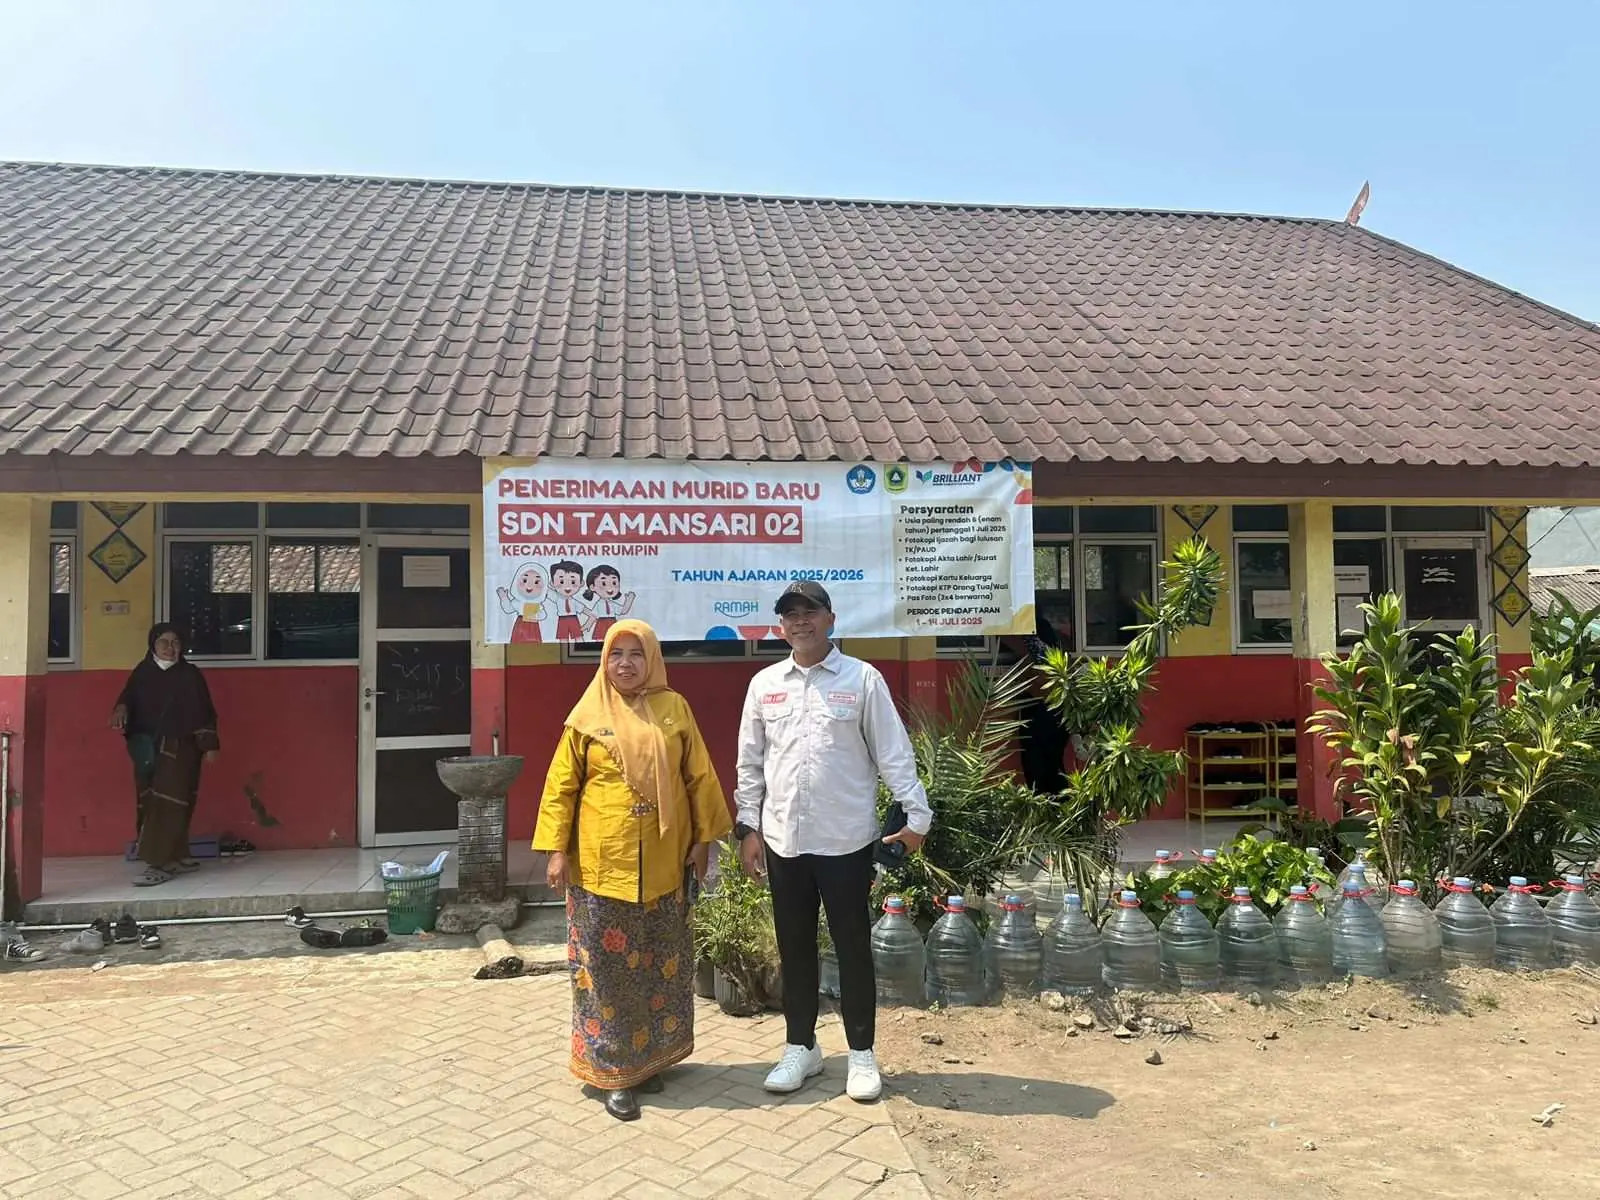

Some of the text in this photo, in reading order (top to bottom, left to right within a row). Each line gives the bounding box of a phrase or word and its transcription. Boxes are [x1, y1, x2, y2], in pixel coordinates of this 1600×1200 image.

[932, 473, 983, 483] BRILLIANT
[498, 479, 821, 500] PENERIMAAN MURID BARU
[900, 505, 974, 516] Persyaratan
[501, 511, 801, 537] SDN TAMANSARI 02
[922, 517, 944, 525] paling
[945, 516, 971, 524] rendah
[978, 515, 1002, 523] (enam
[904, 526, 929, 534] tahun)
[930, 526, 971, 534] pertanggal
[959, 535, 977, 543] bagi
[502, 545, 659, 556] KECAMATAN RUMPIN
[905, 545, 937, 554] TK/PAUD
[671, 569, 864, 581] TAHUN AJARAN 2025/2026
[905, 575, 938, 583] Fotokopi
[976, 582, 1009, 591] Tua/Wali
[954, 592, 993, 601] berwarna)
[714, 601, 759, 613] RAMAH
[941, 607, 1001, 615] PENDAFTARAN
[961, 617, 983, 625] 2025
